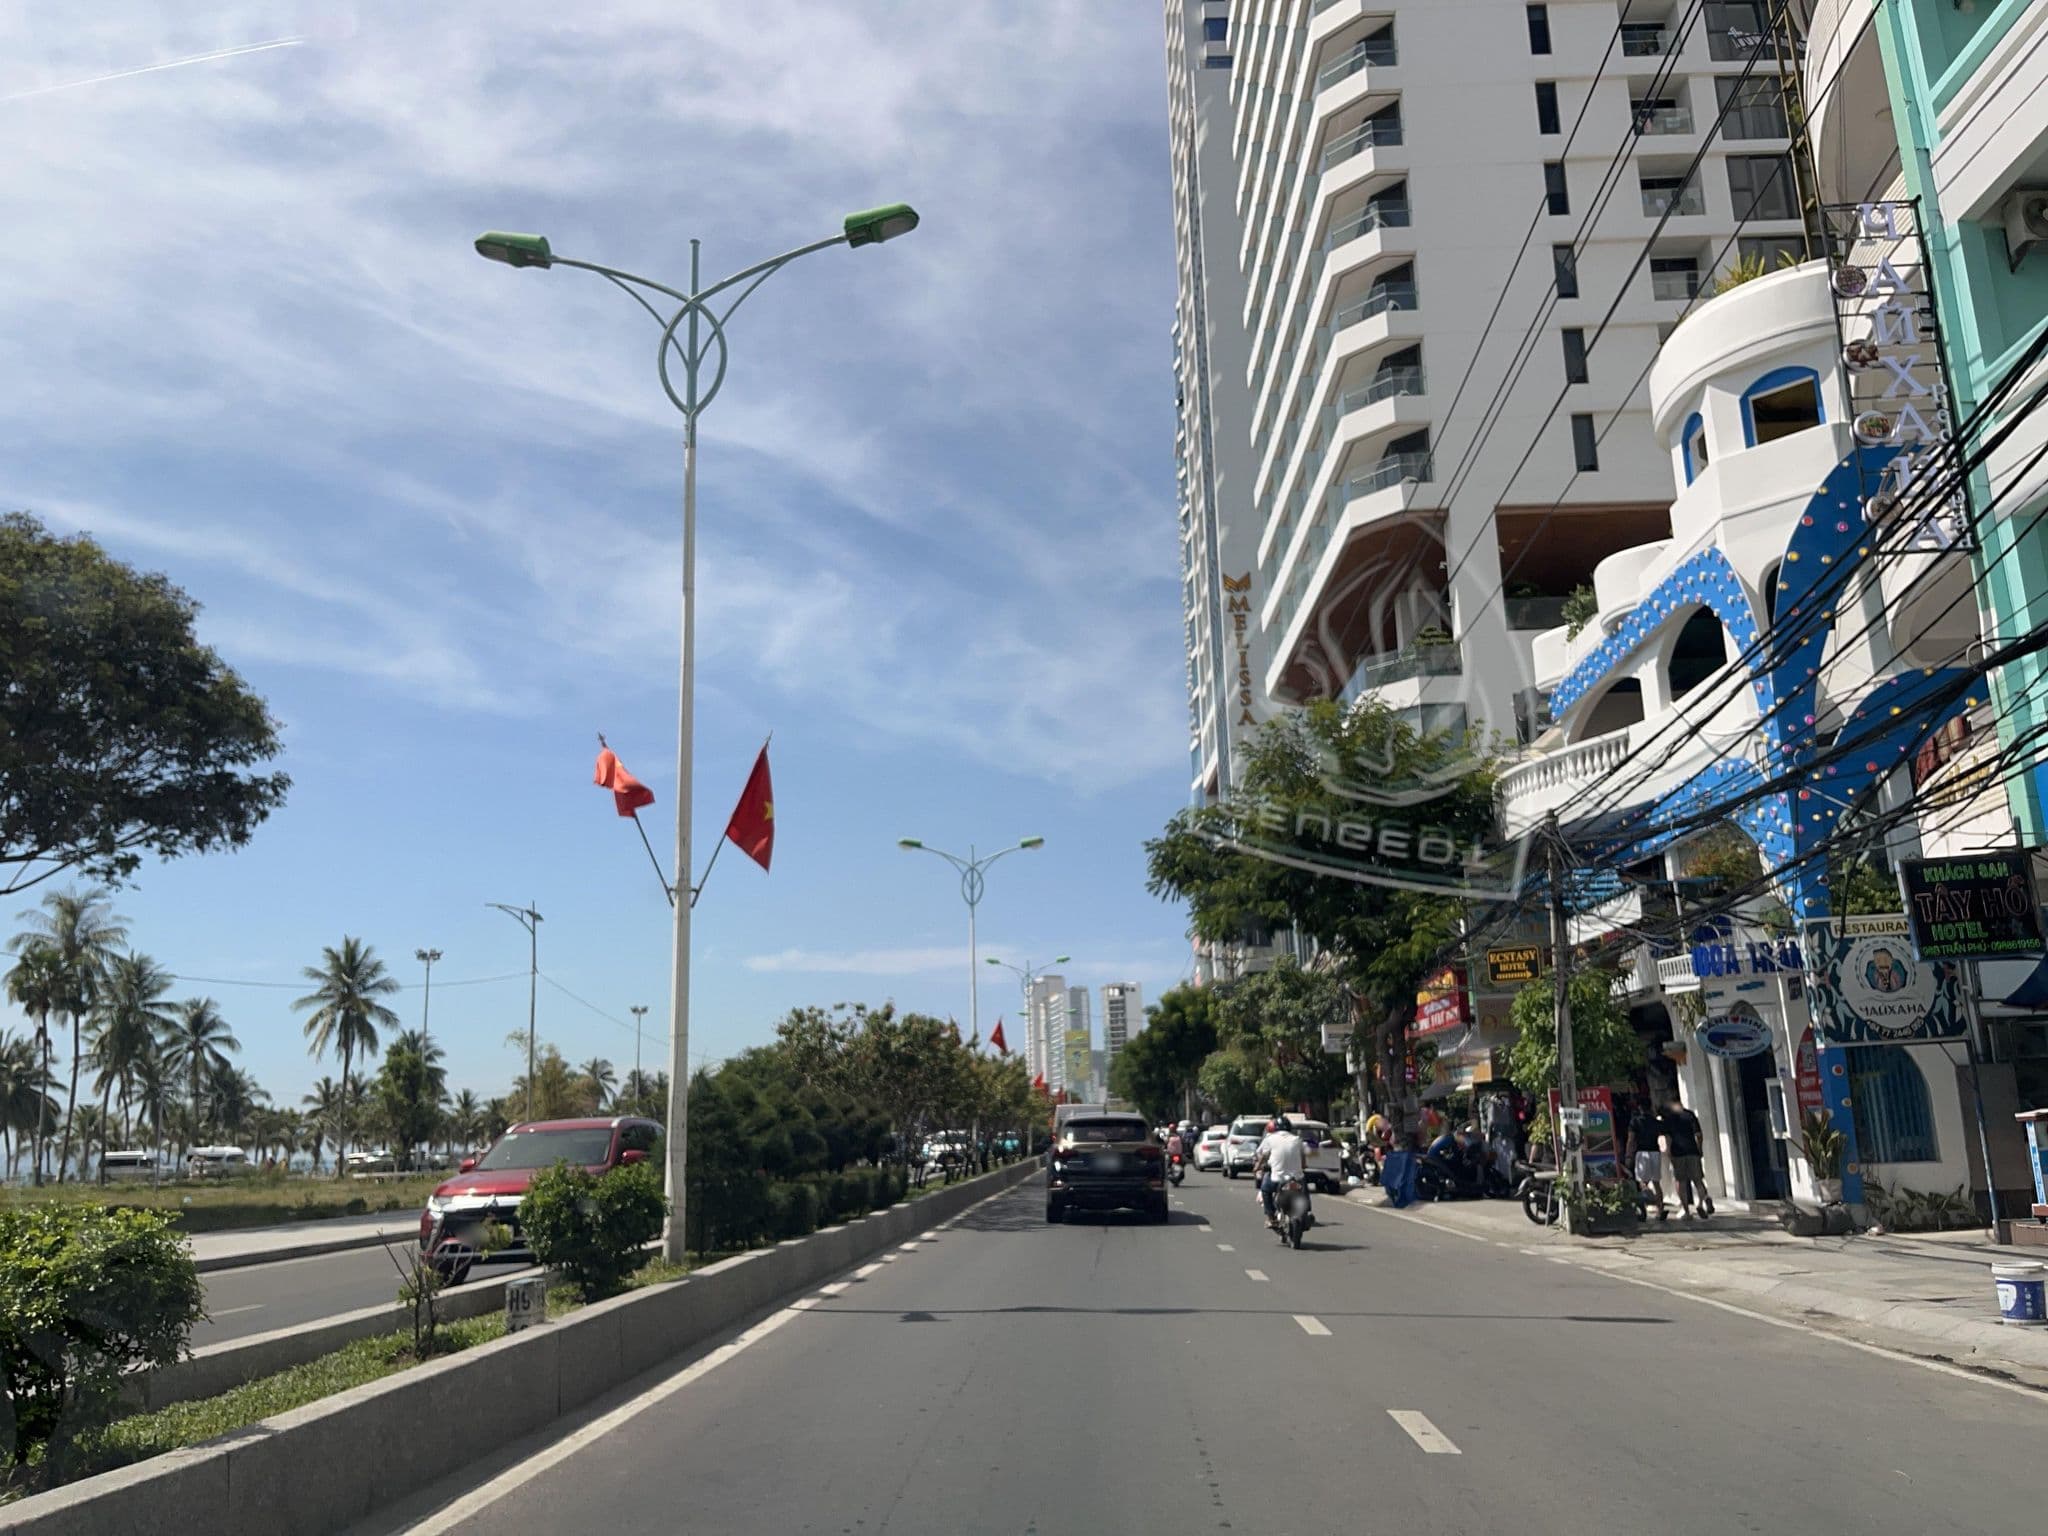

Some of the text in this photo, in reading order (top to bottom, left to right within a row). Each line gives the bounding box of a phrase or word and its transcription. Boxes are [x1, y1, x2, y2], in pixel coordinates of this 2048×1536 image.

[1227, 595, 1257, 726] MELISSA
[1923, 863, 1975, 883] KHÁCH
[1914, 882, 1972, 923] TÂY
[1931, 920, 1988, 941] HOTEL
[1489, 949, 1536, 963] ECSTASY
[1499, 961, 1528, 971] HOTEL
